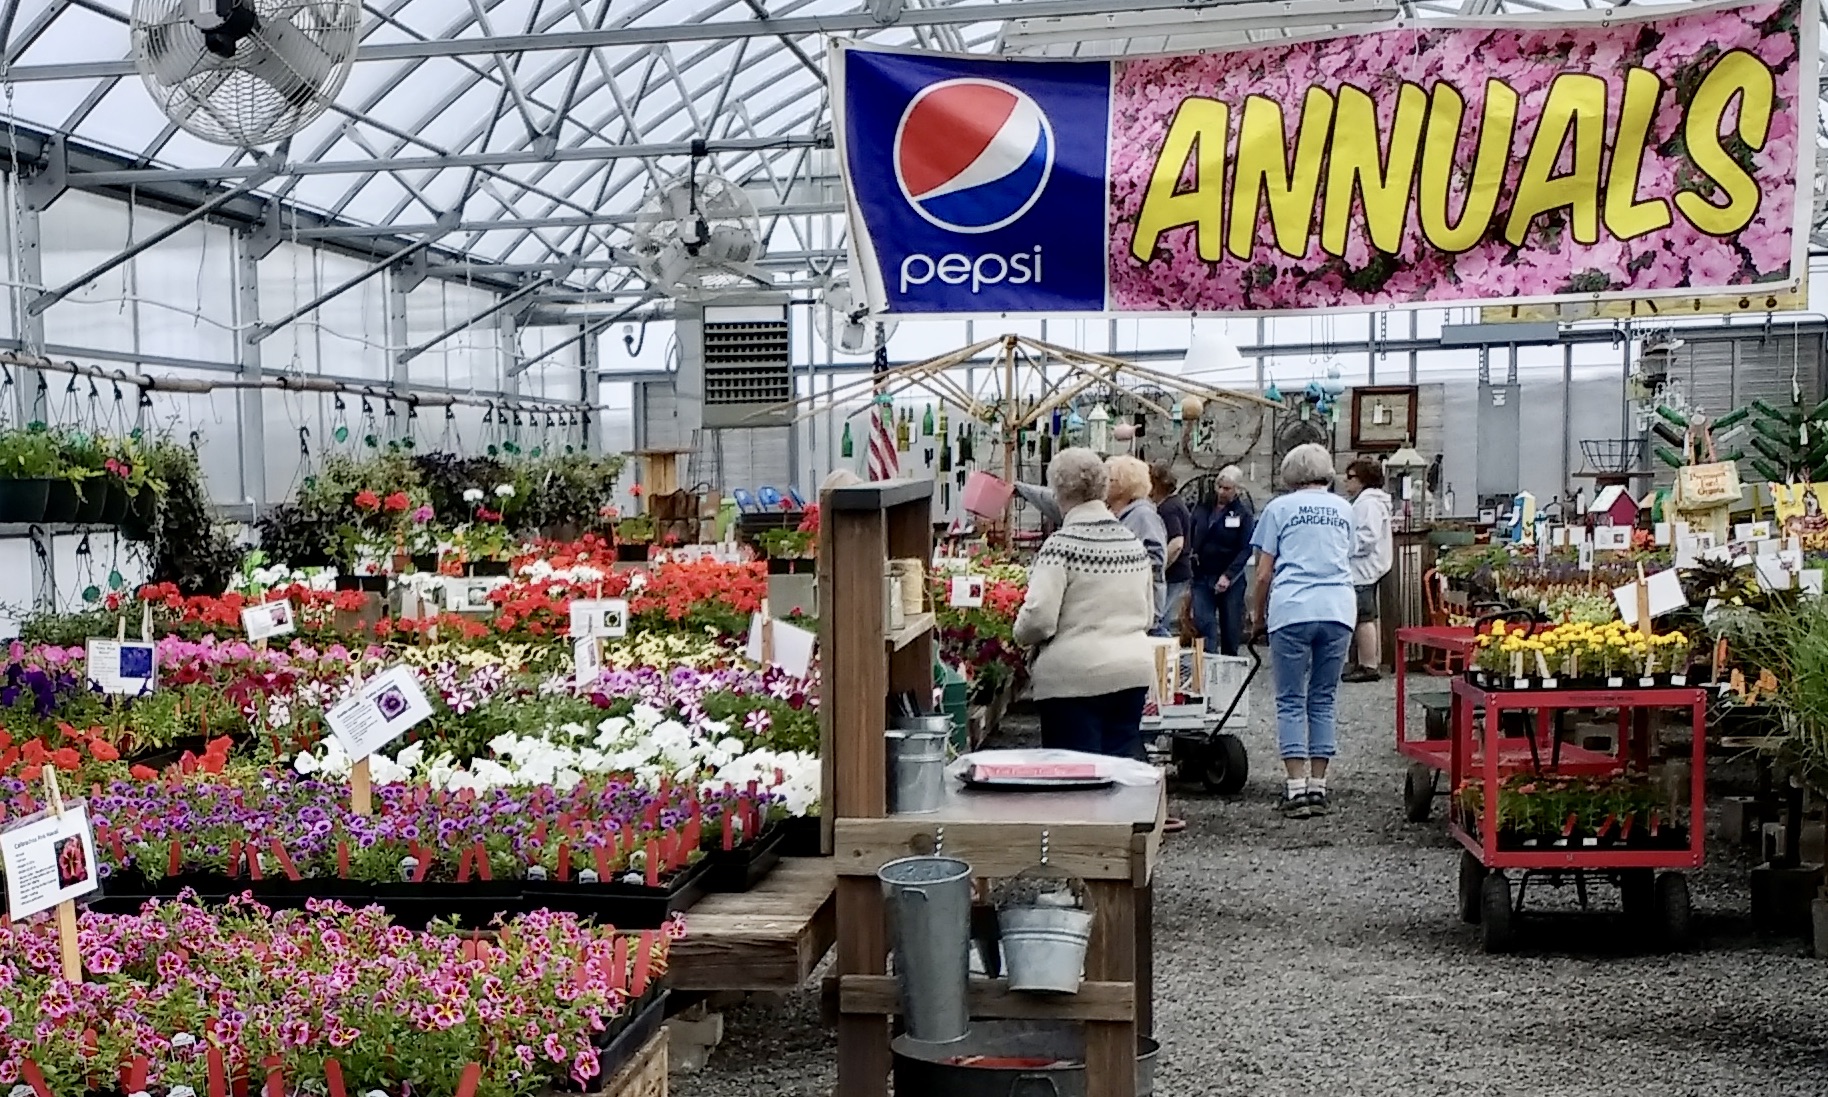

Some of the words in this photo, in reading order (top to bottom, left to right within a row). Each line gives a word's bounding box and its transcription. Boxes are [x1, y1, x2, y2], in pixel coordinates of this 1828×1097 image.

[1131, 48, 1776, 262] ANNUALS
[900, 245, 1042, 294] pepsi
[1290, 514, 1345, 529] GARDENER
[1298, 506, 1339, 517] MASTER
